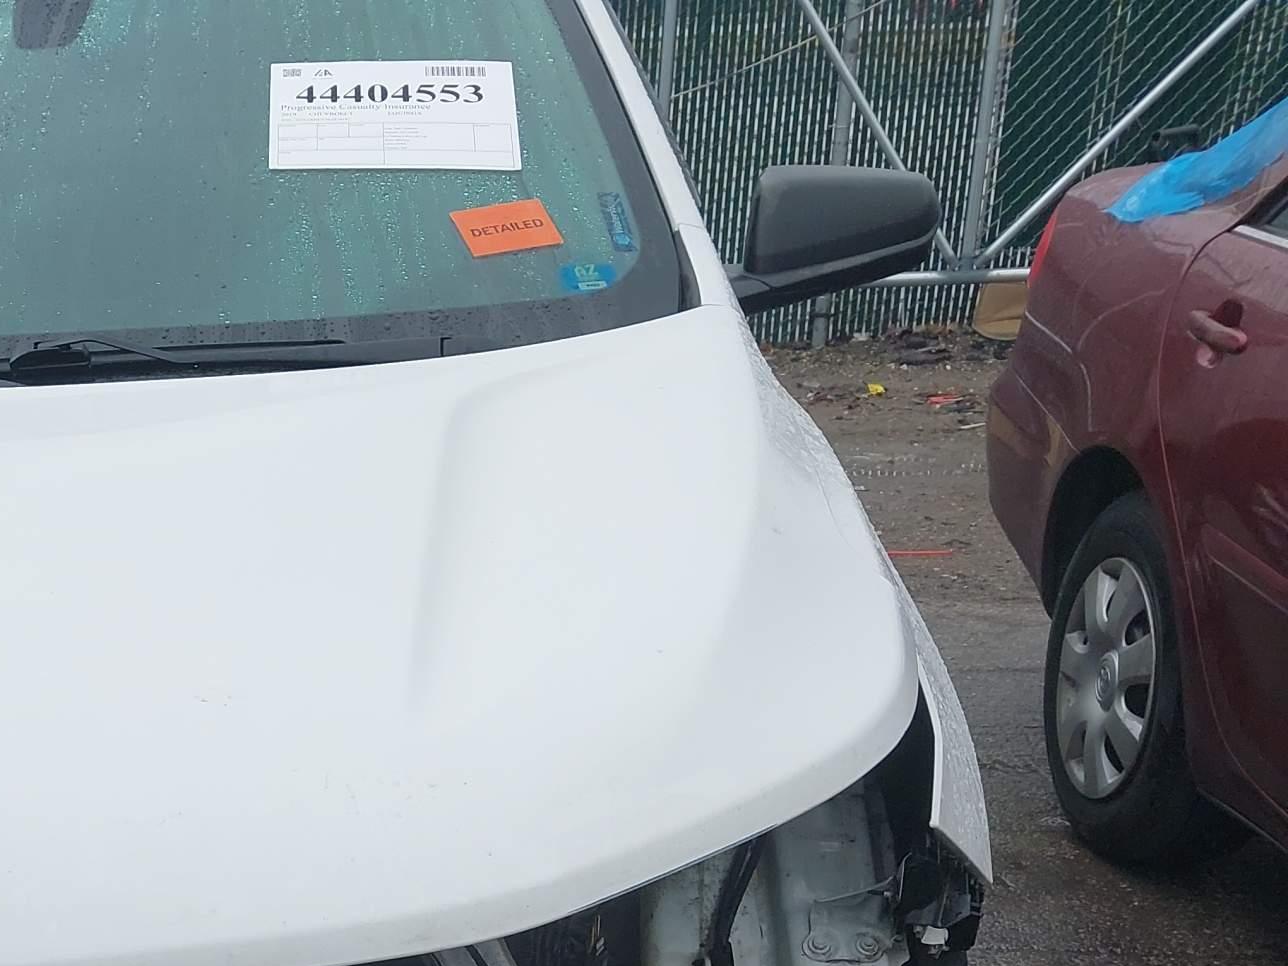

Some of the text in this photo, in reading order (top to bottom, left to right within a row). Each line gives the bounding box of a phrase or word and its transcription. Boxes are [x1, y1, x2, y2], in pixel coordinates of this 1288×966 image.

[296, 84, 484, 103] 44404553
[281, 104, 337, 112] Progressive
[470, 218, 544, 238] DETAILED
